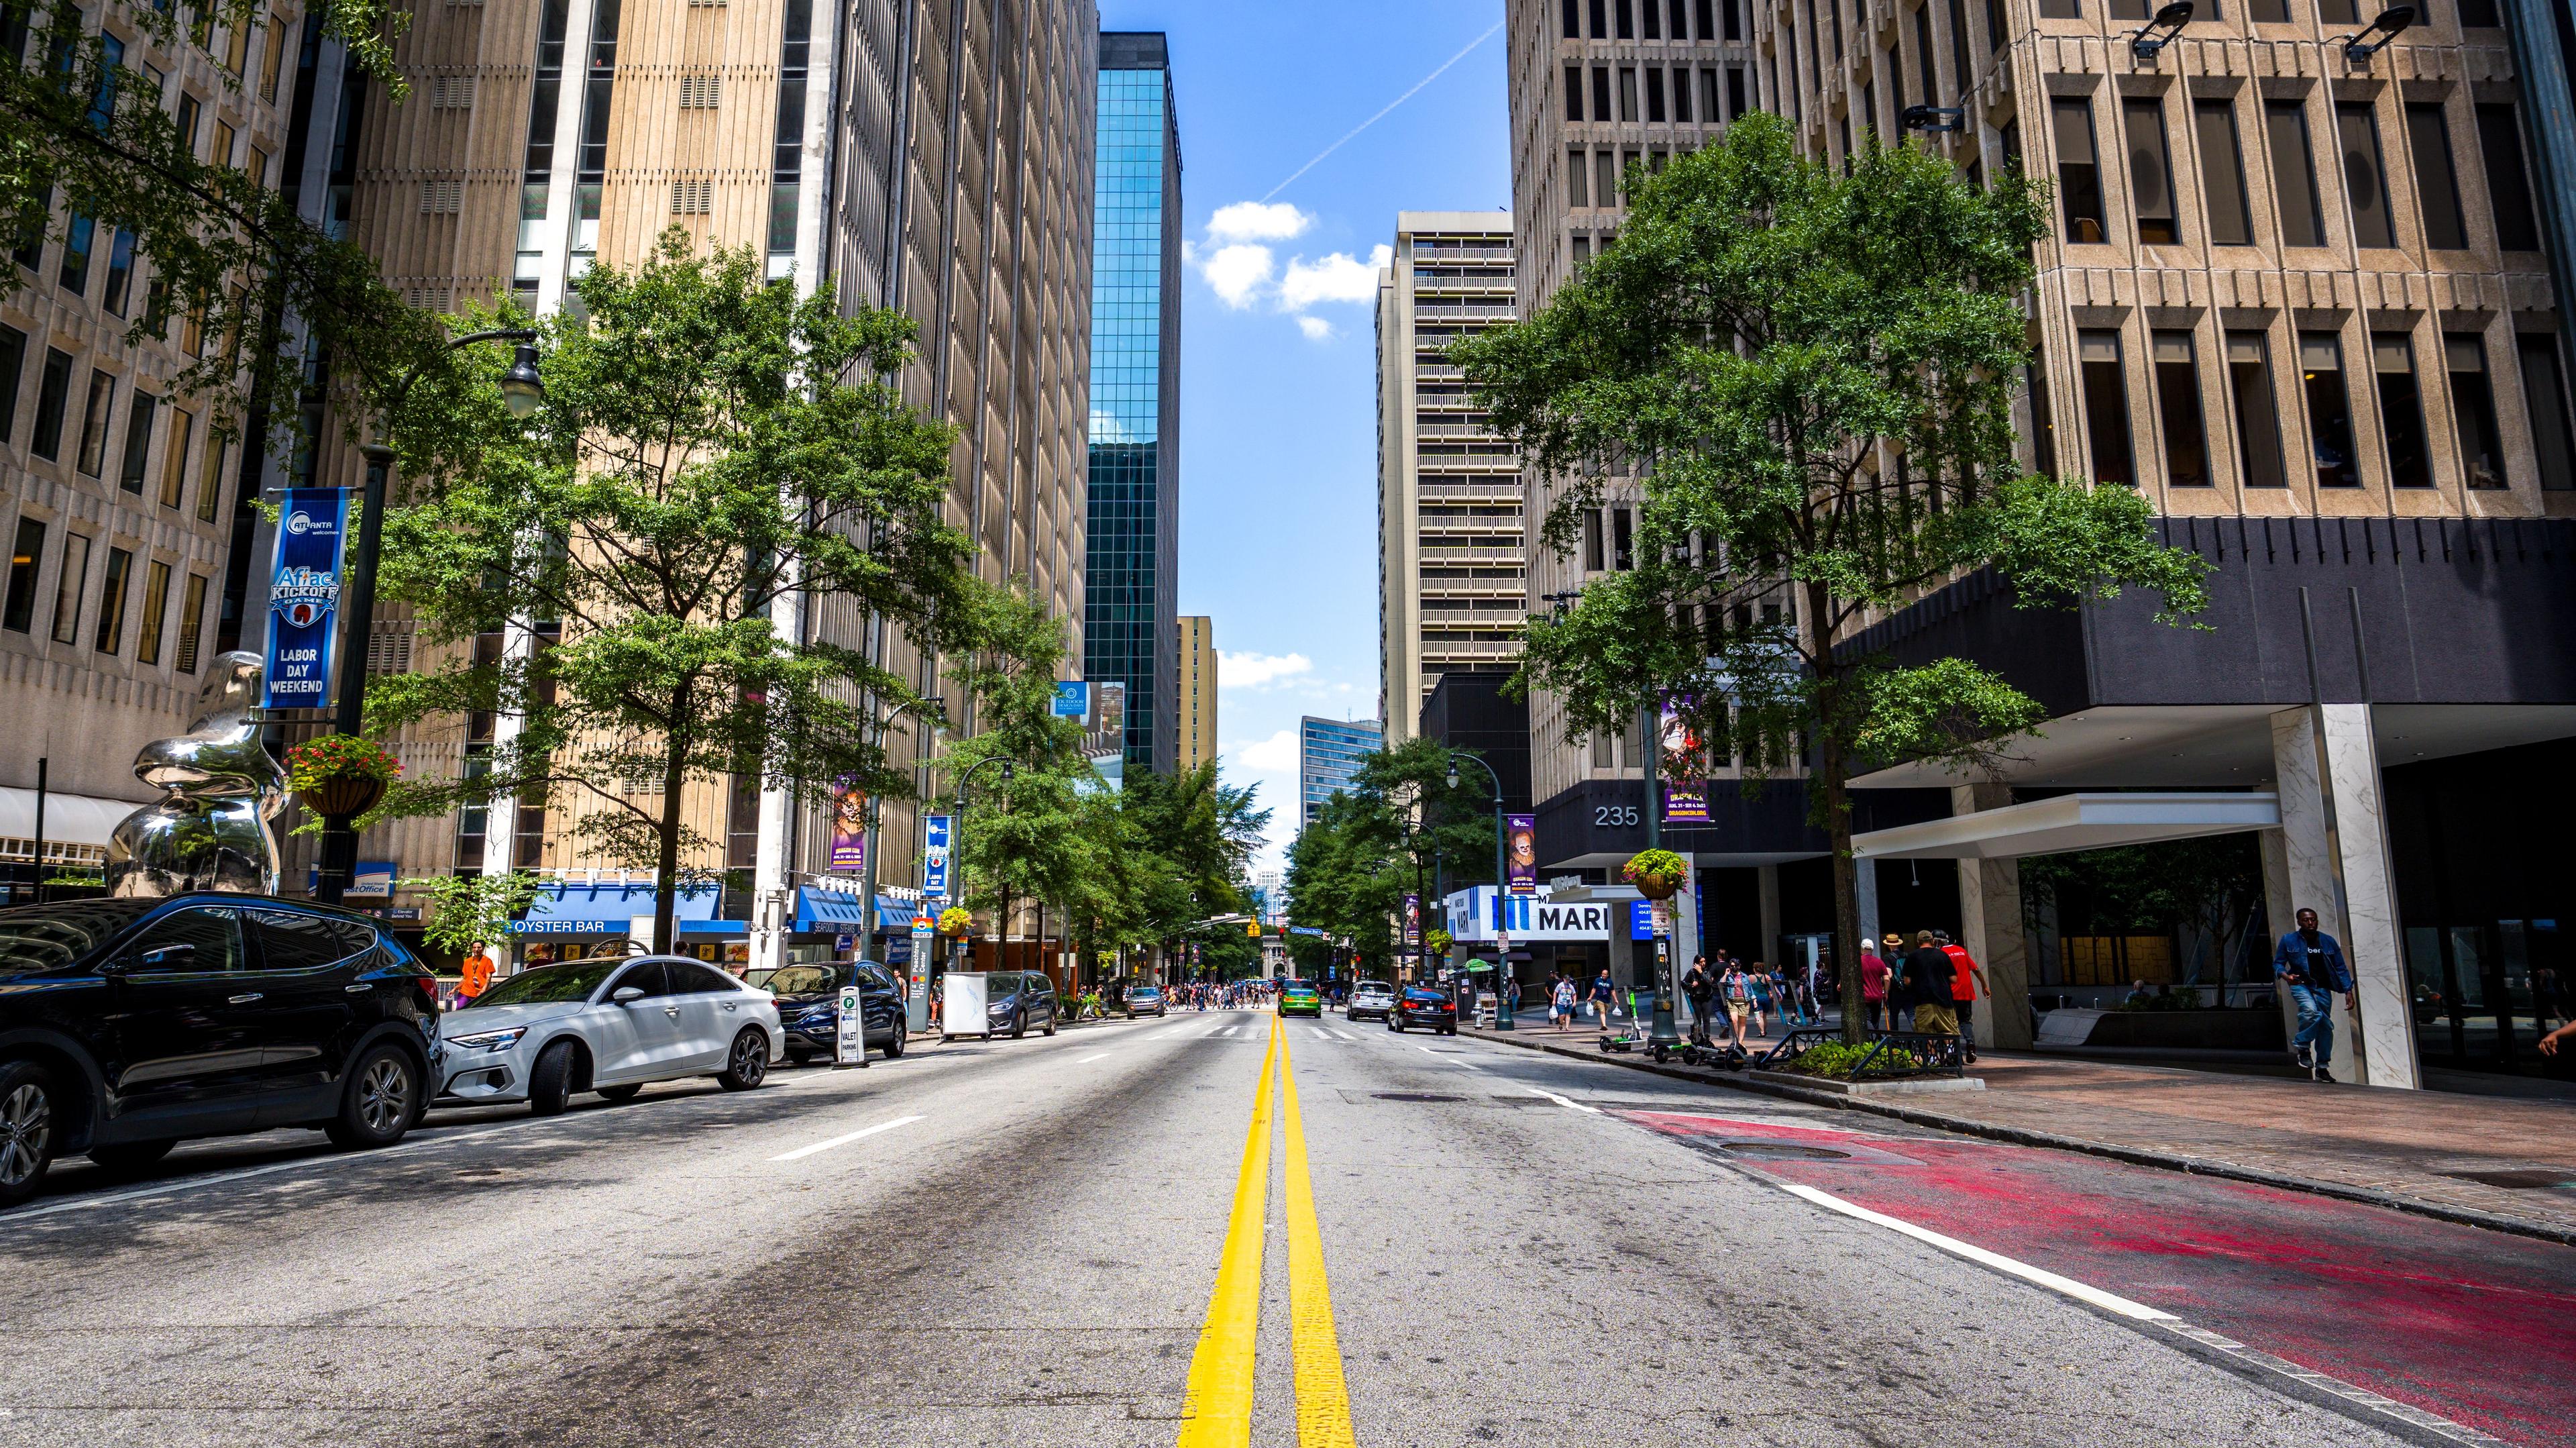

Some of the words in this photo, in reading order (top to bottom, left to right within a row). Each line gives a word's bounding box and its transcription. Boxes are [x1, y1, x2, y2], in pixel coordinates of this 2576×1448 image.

[273, 585, 337, 601] KICKOFF
[280, 649, 317, 661] LABOR
[286, 665, 309, 677] DAY
[270, 680, 323, 693] WEEKEND
[1595, 806, 1638, 826] 235
[360, 885, 384, 893] Office
[515, 921, 572, 932] OYSTER
[576, 921, 604, 932] BAR
[1457, 910, 1469, 933] MARK
[814, 923, 835, 933] SEAFOOD
[840, 923, 855, 933] STEAKS
[847, 999, 852, 1007] P
[842, 1032, 857, 1041] VALET
